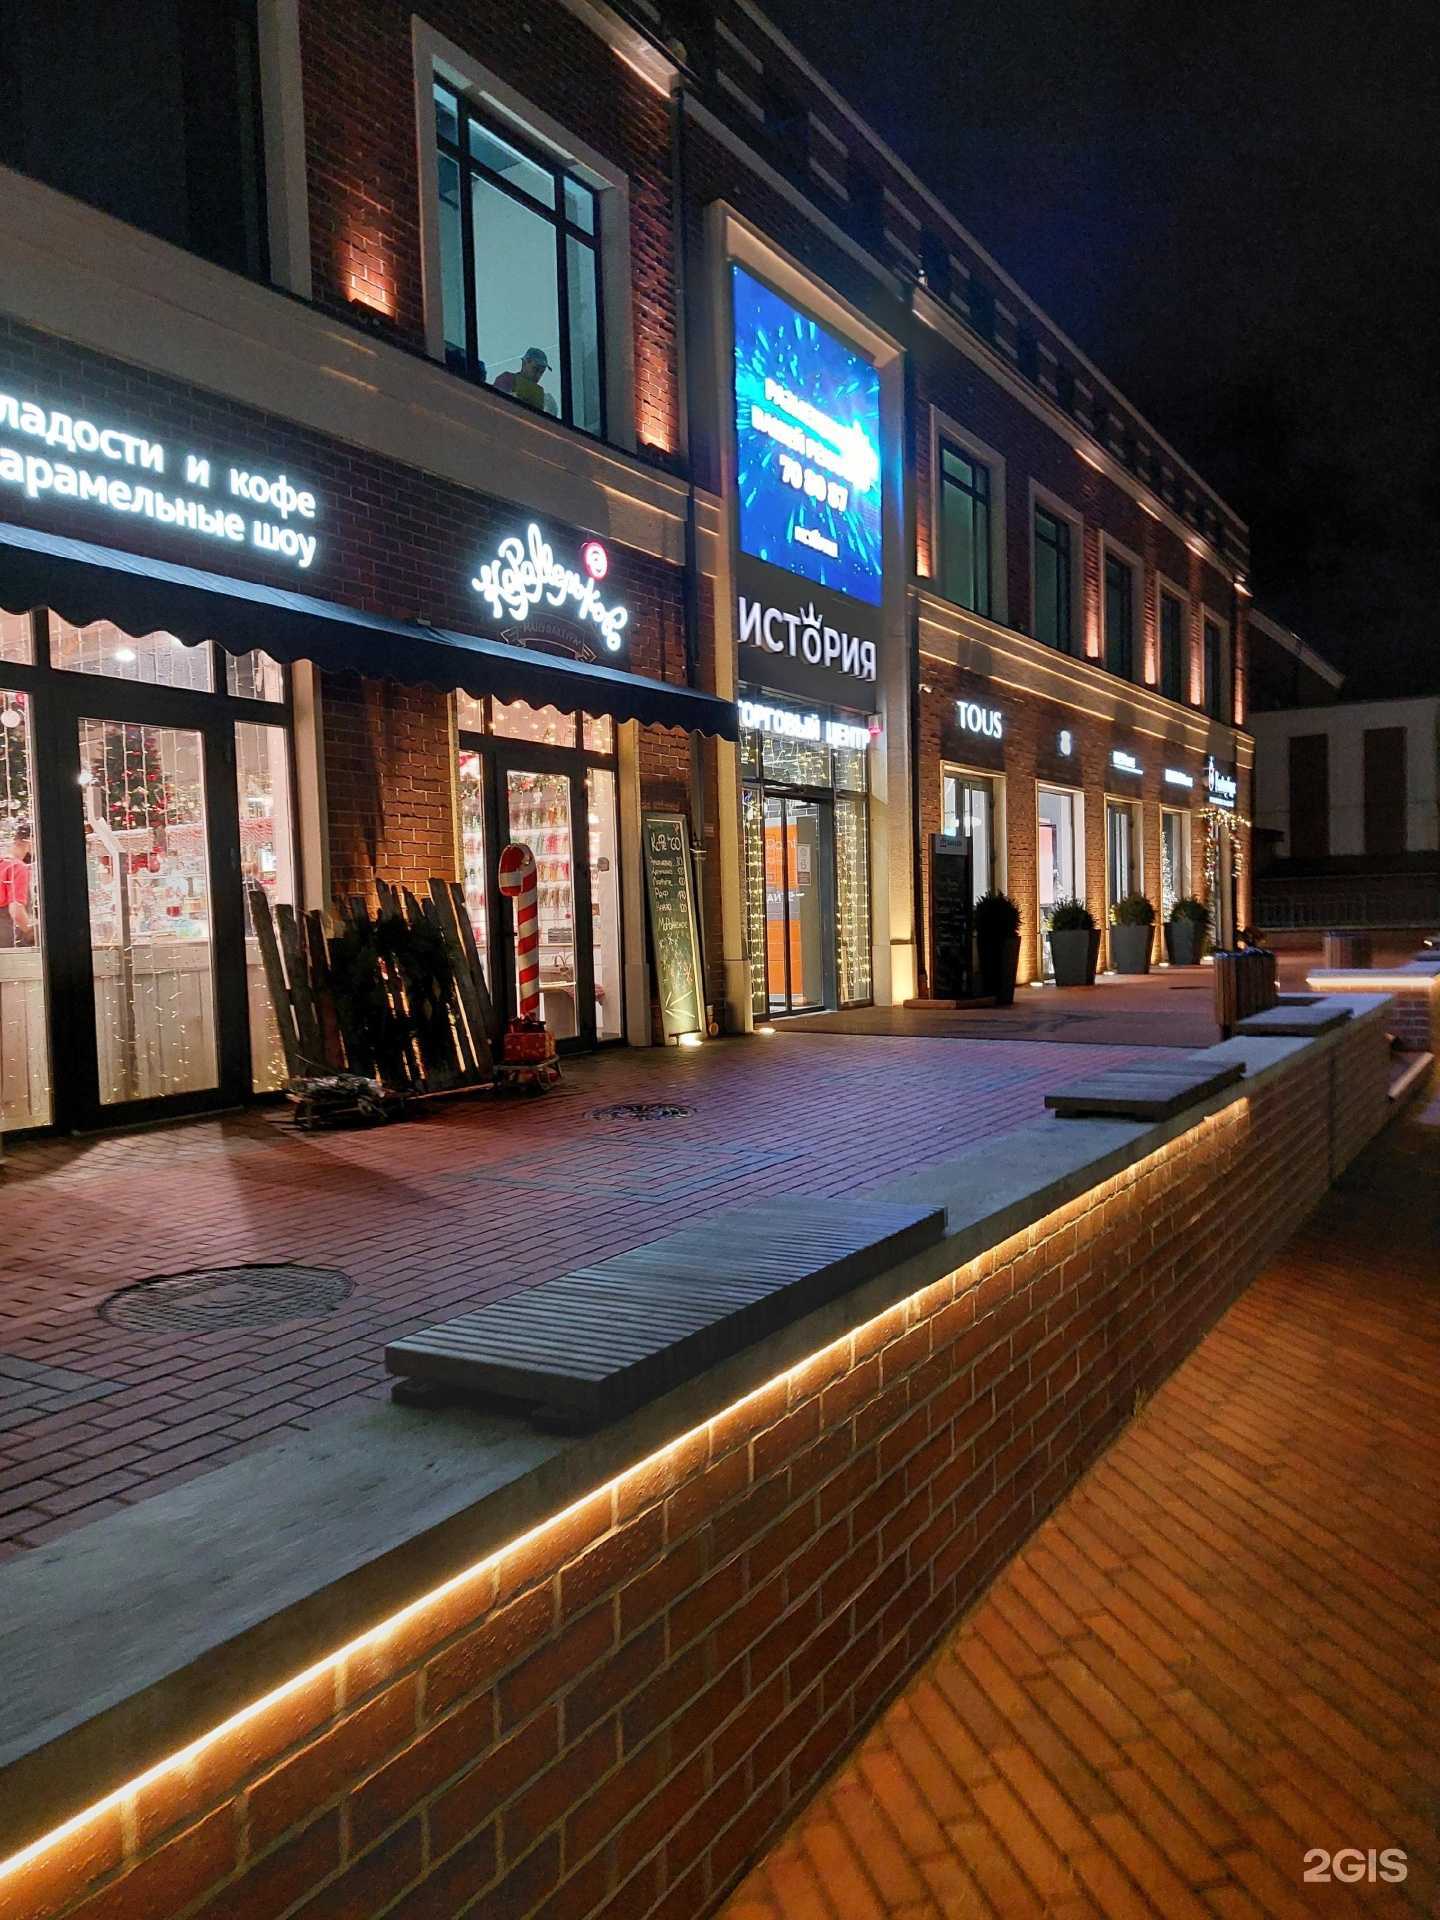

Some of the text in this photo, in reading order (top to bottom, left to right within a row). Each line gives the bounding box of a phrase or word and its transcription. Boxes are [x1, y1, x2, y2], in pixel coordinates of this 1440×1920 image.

[186, 455, 210, 488] и
[230, 468, 316, 520] кофе
[253, 520, 316, 568] шоу
[738, 597, 877, 682] ИСТОРИЯ
[956, 701, 1003, 740] TOUS
